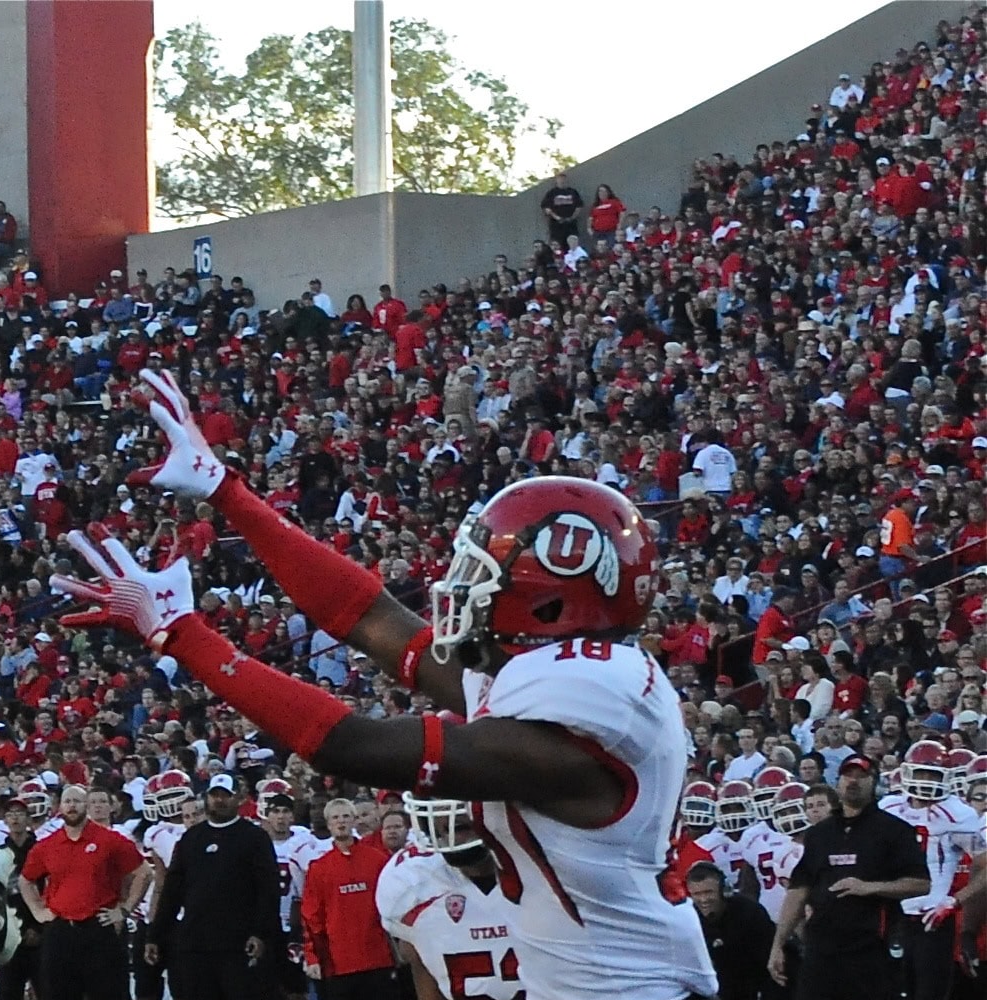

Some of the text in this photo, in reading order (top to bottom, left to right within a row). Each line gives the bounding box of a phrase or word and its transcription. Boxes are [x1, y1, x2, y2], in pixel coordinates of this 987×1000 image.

[194, 243, 212, 273] 16
[546, 521, 594, 571] U
[339, 881, 367, 894] UTAH
[470, 925, 508, 940] UTAH
